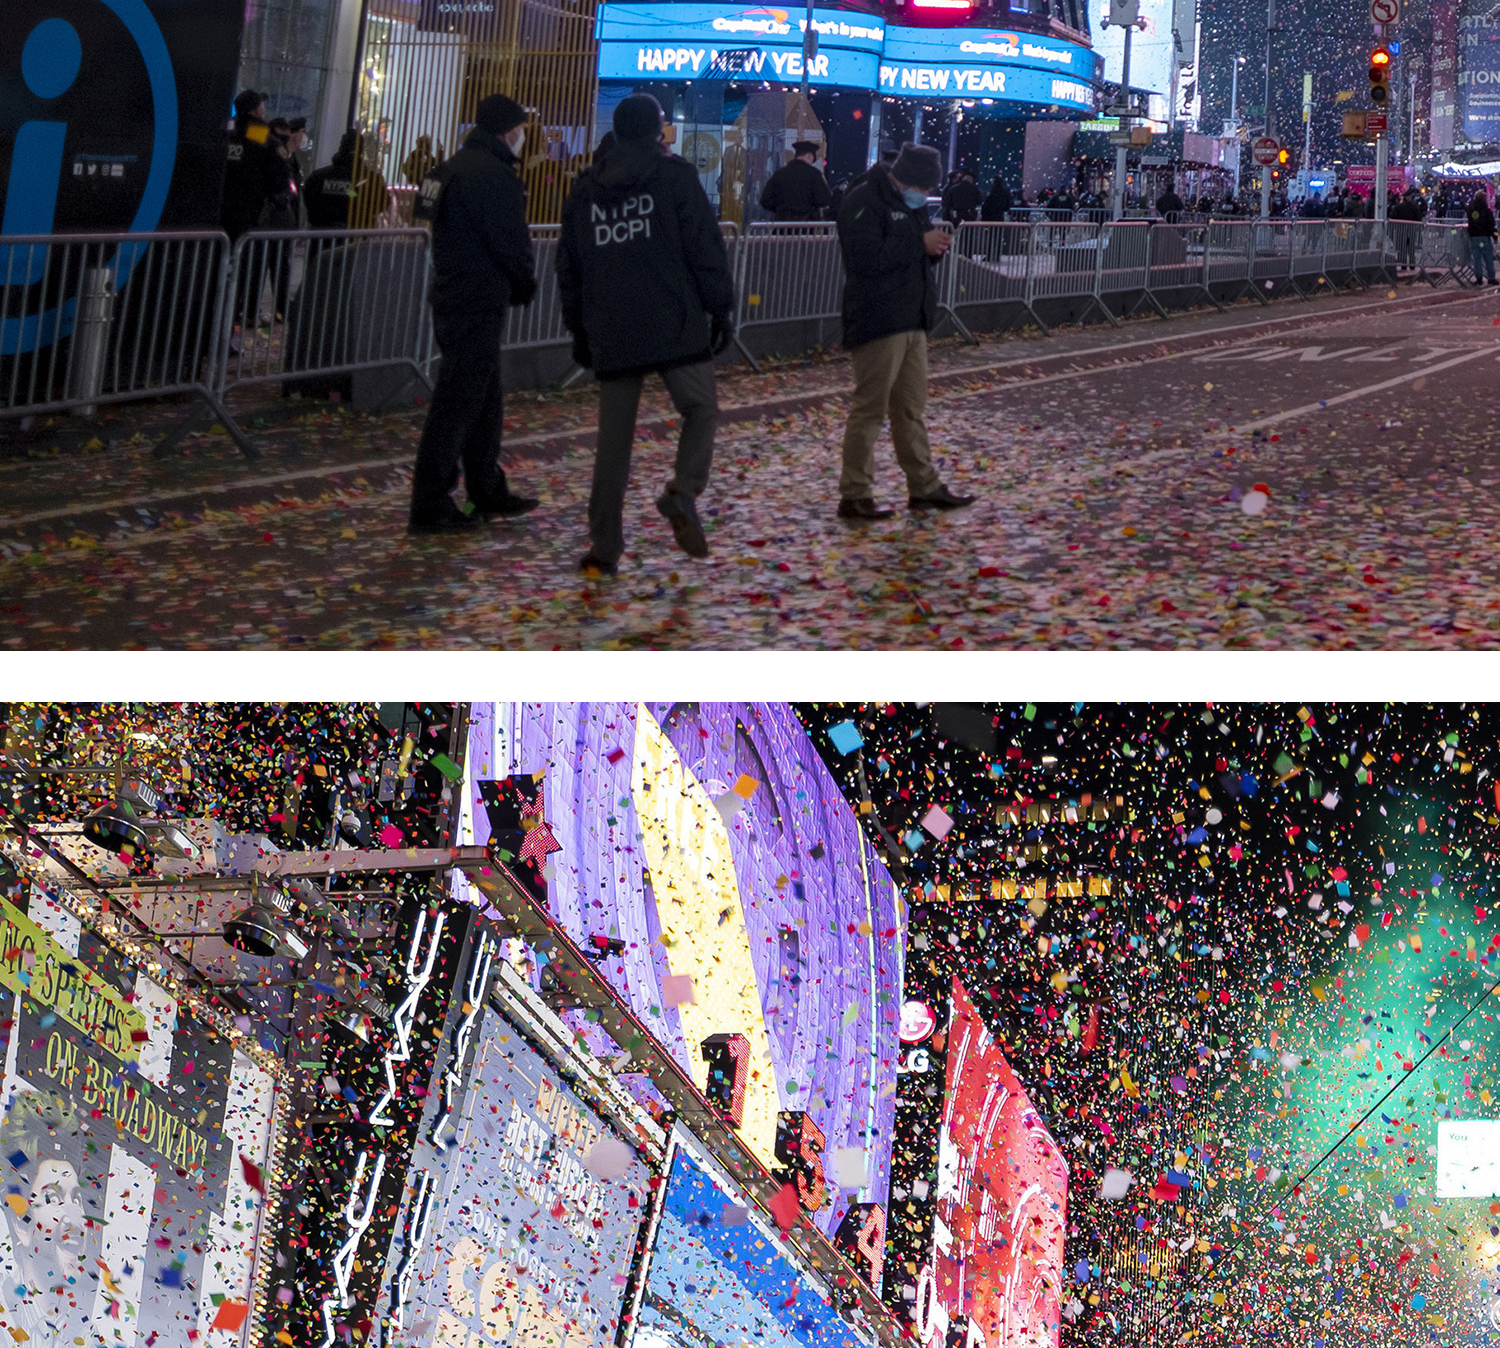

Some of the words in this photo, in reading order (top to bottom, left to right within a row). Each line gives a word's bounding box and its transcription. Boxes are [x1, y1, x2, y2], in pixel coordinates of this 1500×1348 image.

[638, 49, 702, 73] HAPPY
[711, 49, 765, 74] NEW
[773, 51, 829, 77] YEAR
[901, 65, 945, 90] NEW
[952, 69, 1006, 92] YEAR
[595, 218, 652, 247] DCPI
[47, 1031, 75, 1091] ON
